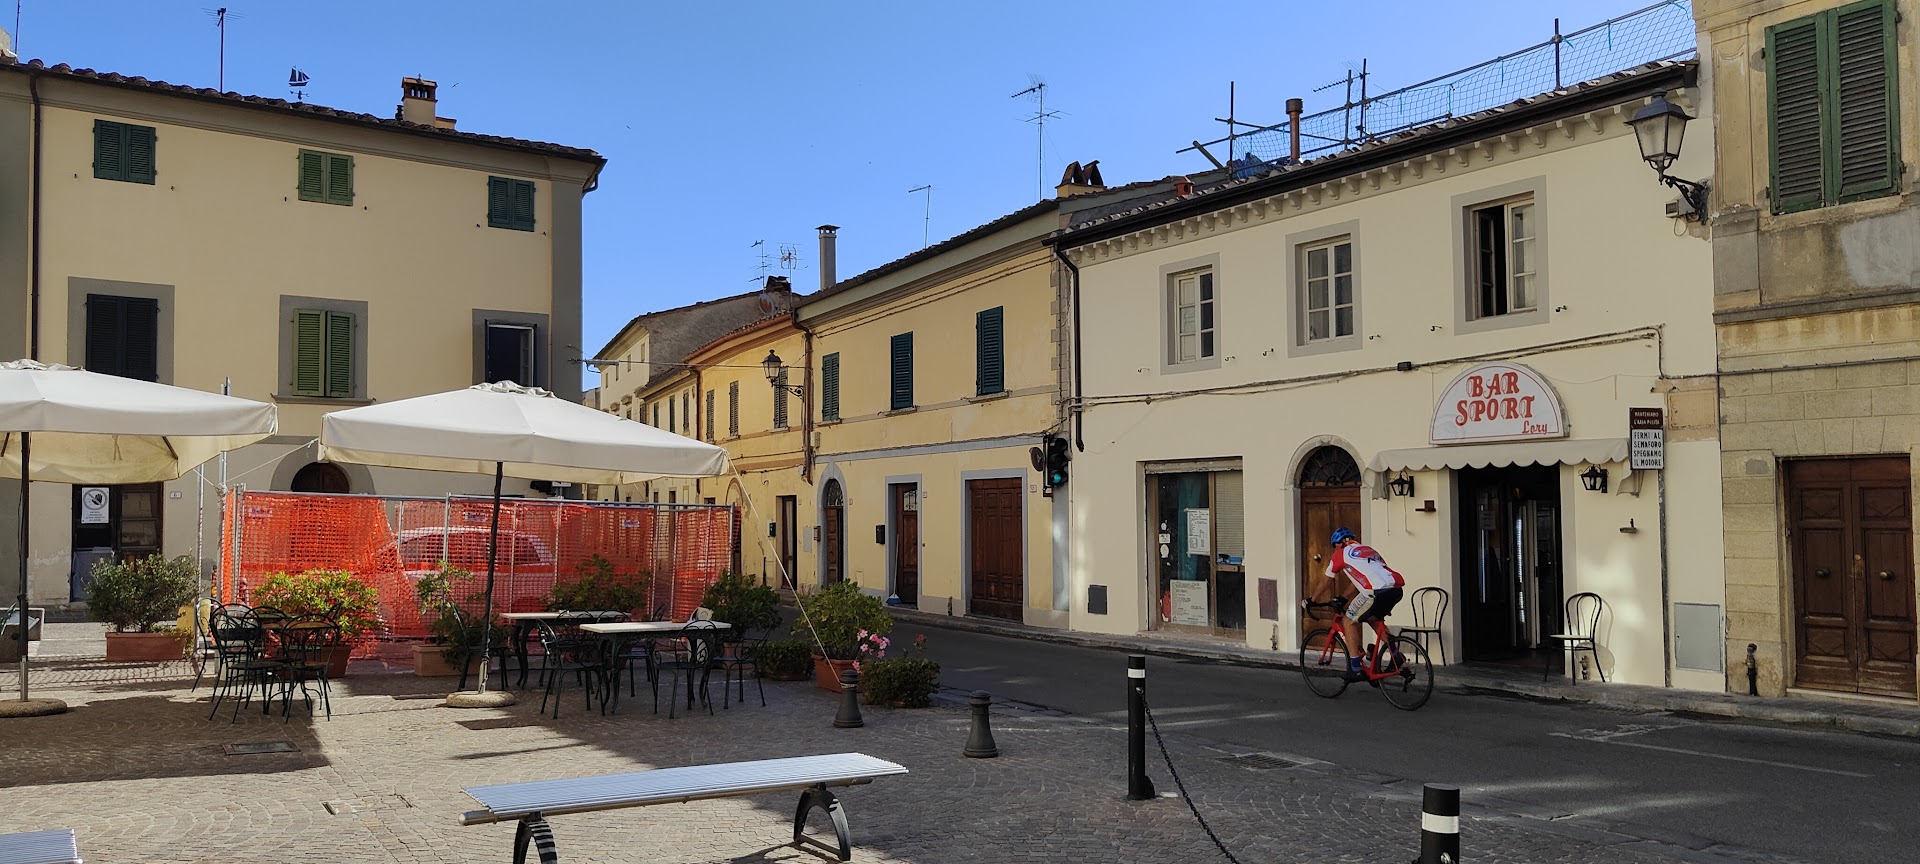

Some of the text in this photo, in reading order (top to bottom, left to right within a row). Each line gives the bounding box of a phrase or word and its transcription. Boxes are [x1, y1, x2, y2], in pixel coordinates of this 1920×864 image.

[1466, 372, 1520, 399] BAR
[1455, 395, 1535, 426] SPORT
[1522, 420, 1548, 435] Lory
